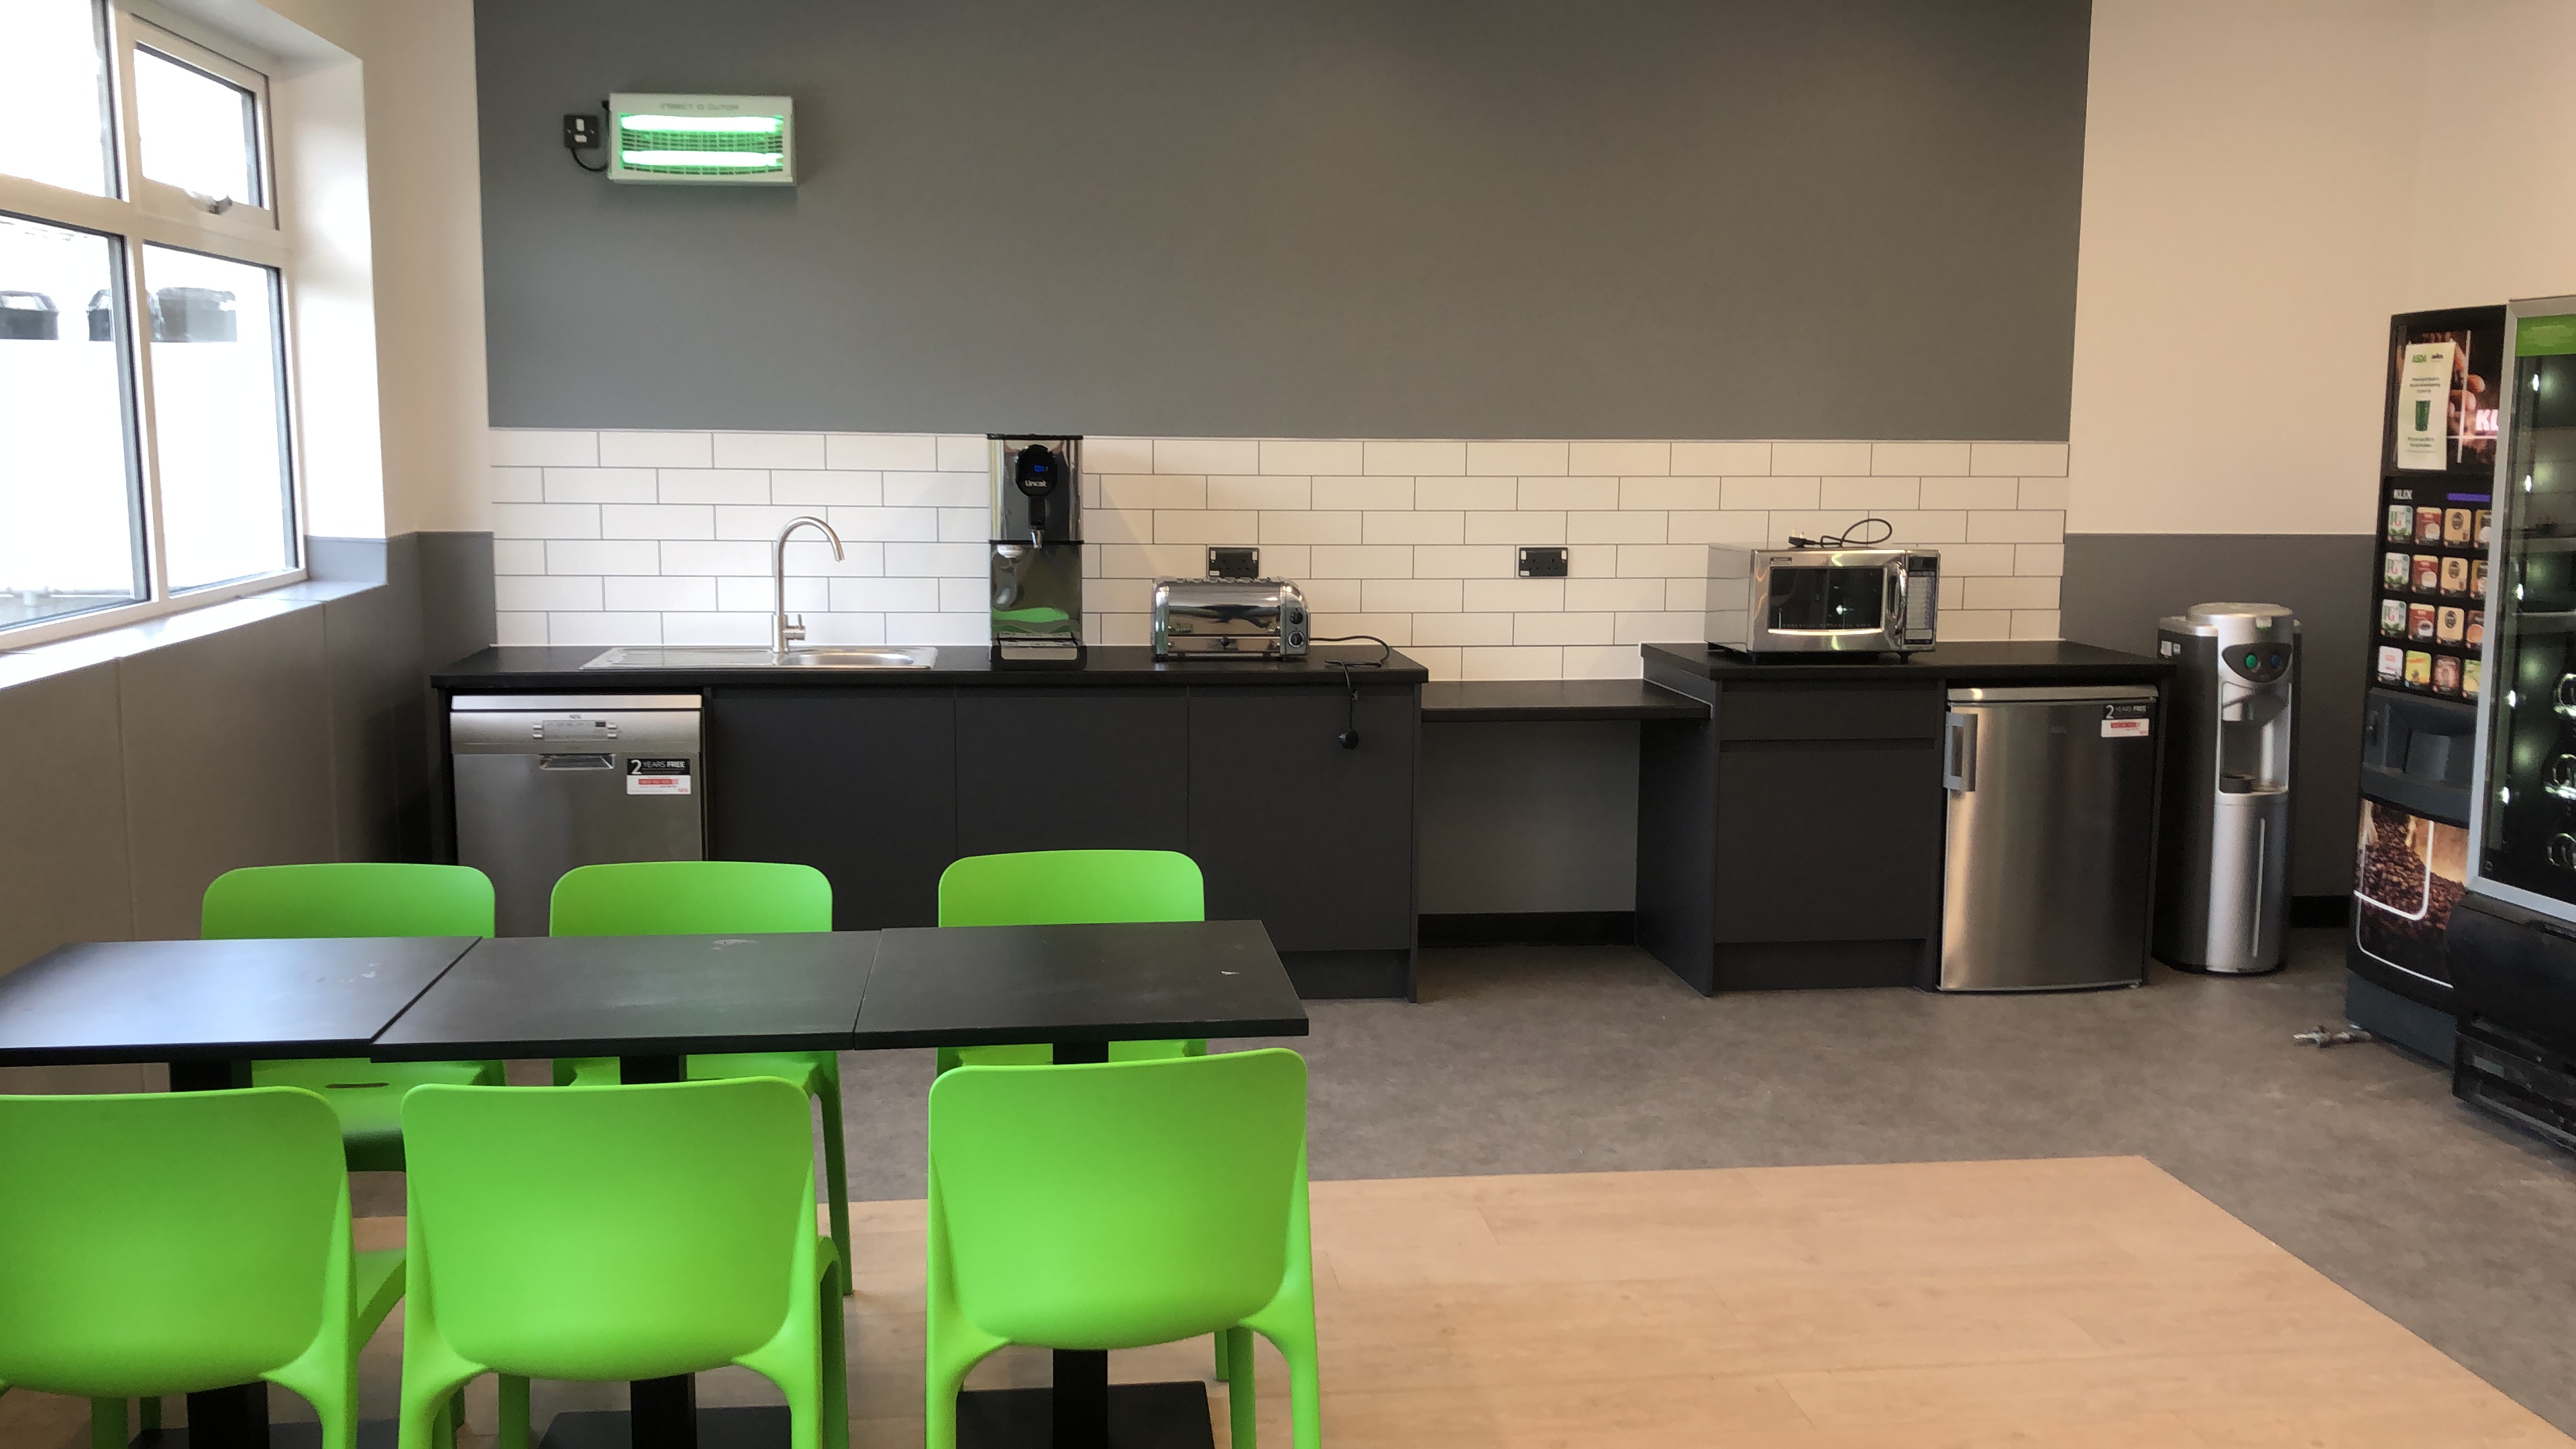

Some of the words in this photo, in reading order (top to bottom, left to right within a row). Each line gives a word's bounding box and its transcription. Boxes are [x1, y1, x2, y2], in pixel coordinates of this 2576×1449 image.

[2475, 409, 2499, 431] KL
[1024, 480, 1047, 488] Lincat
[2393, 489, 2413, 500] KLIX
[2106, 704, 2114, 719] 2
[631, 759, 642, 775] 2
